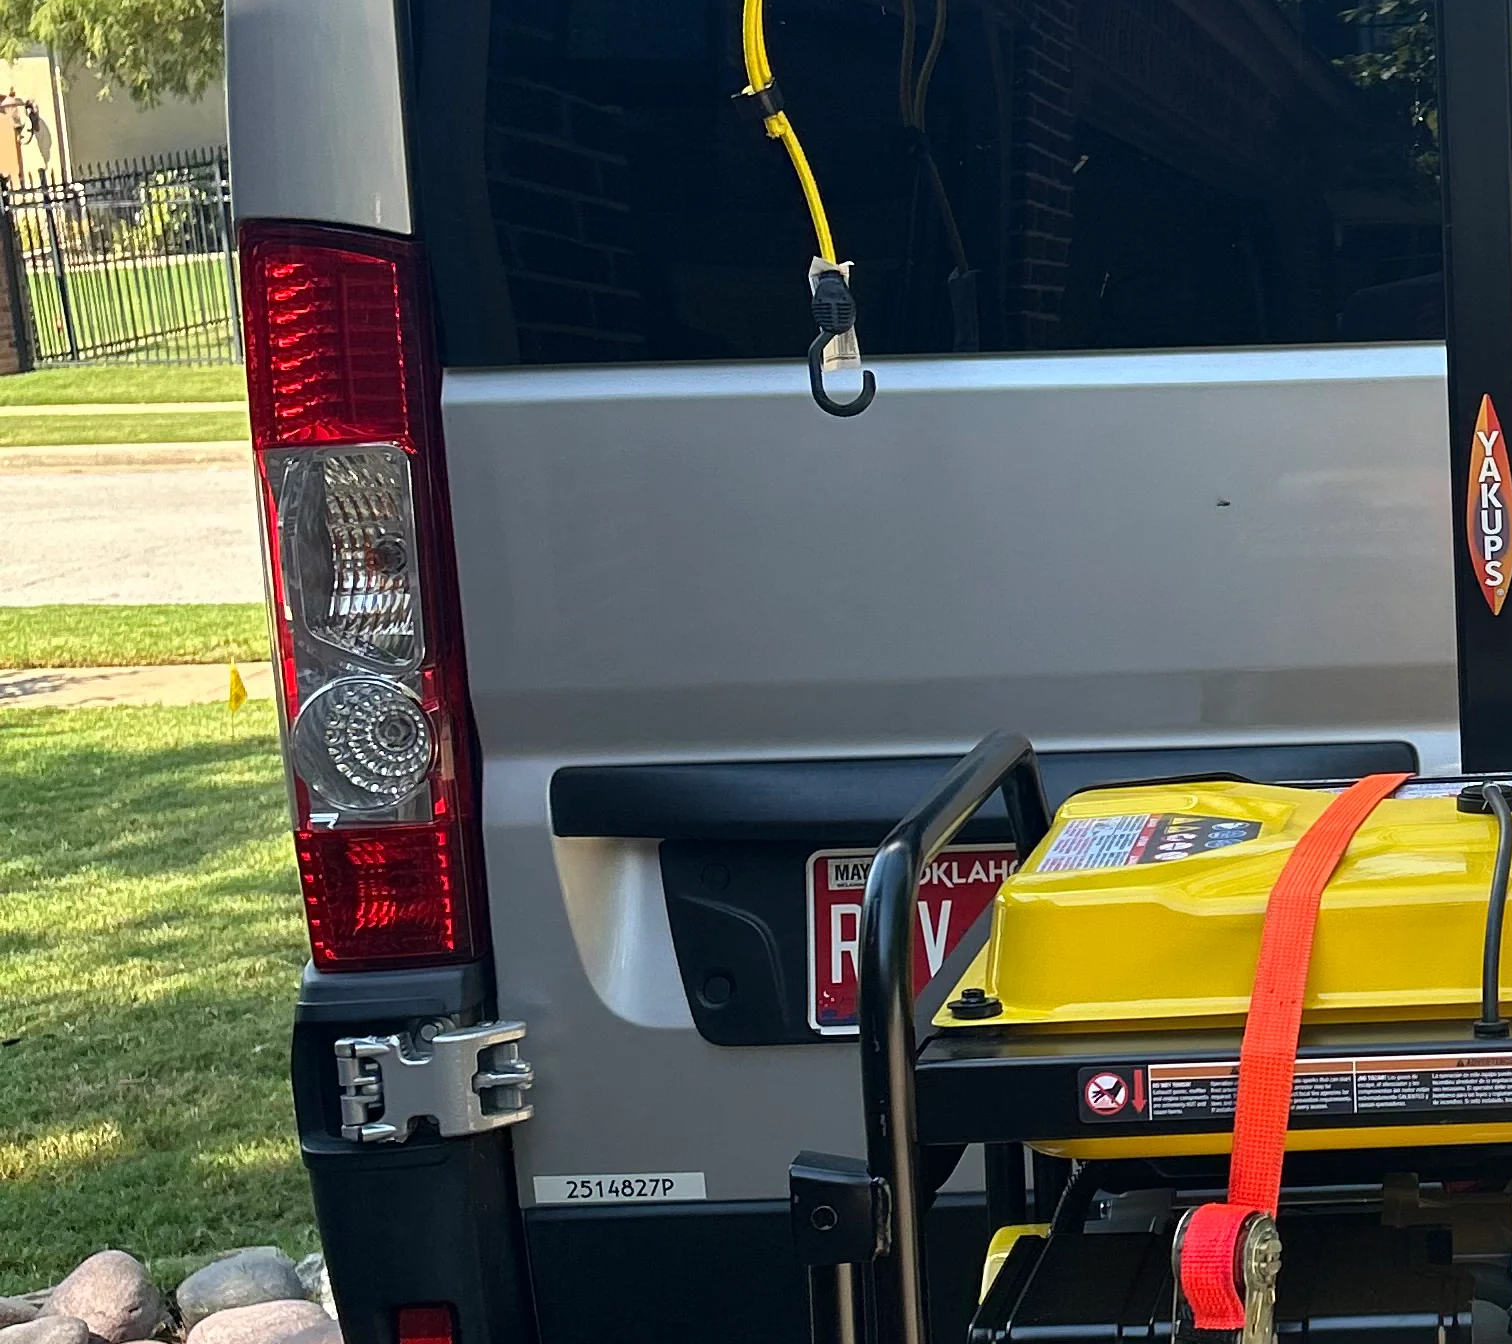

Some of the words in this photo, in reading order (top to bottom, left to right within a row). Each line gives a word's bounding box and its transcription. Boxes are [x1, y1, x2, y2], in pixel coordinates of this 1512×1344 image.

[1476, 430, 1504, 587] YAKUPS
[835, 863, 871, 881] MAY
[565, 1178, 675, 1199] 2514827P
